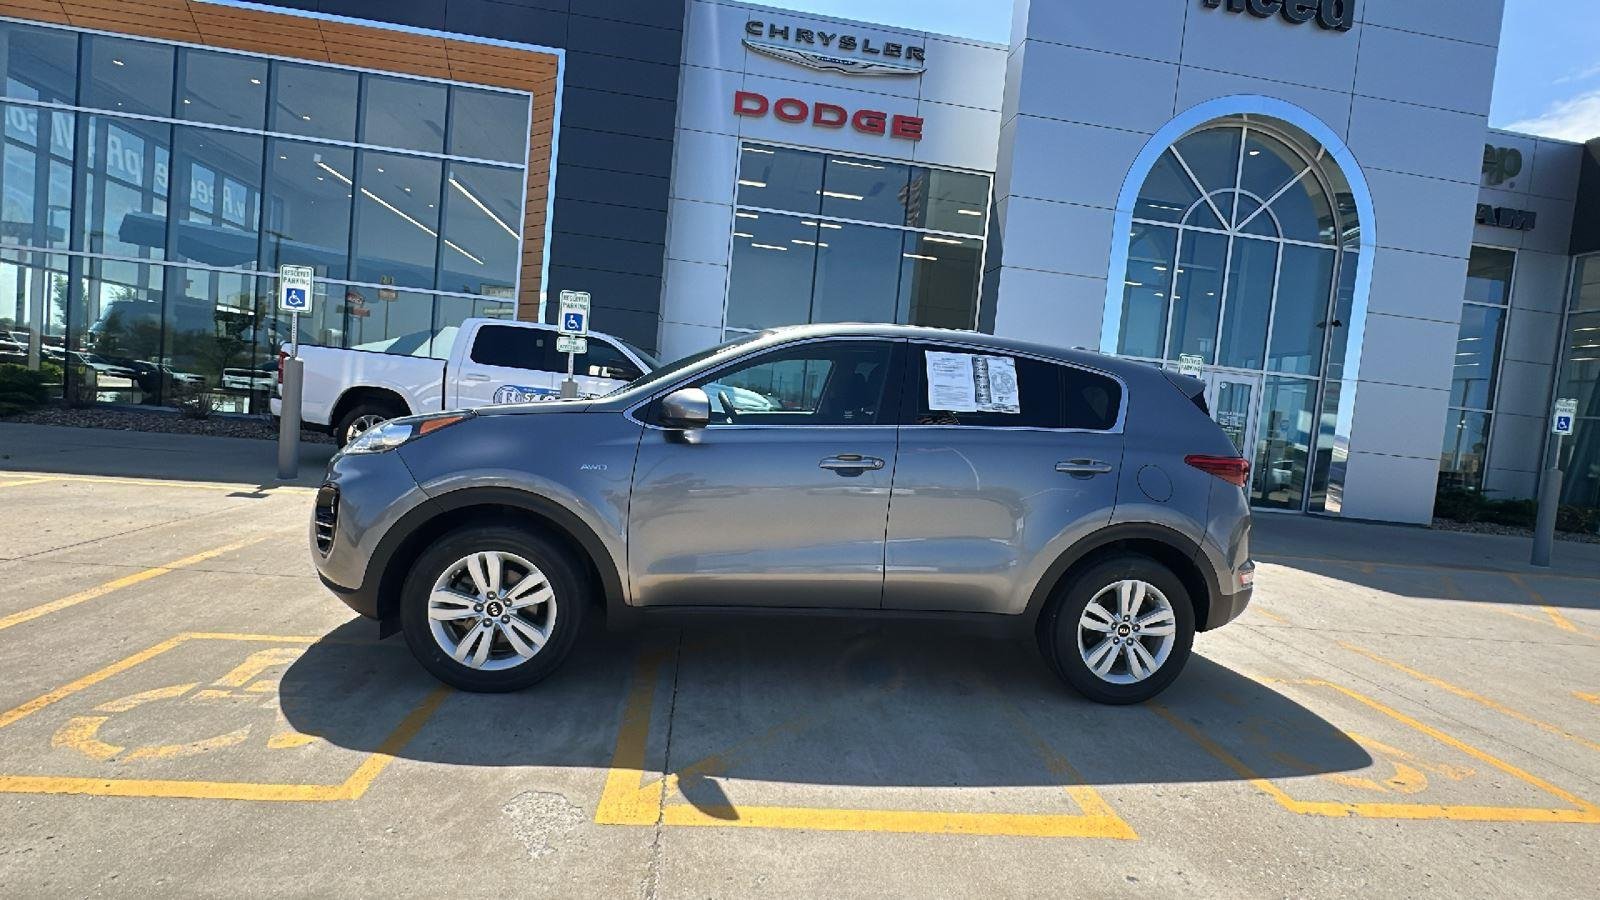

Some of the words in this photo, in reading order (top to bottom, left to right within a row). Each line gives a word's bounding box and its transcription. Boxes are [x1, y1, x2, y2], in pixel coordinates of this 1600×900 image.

[1203, 0, 1355, 32] eed
[745, 20, 925, 61] CHRYSLER
[734, 90, 924, 141] DODGE
[1475, 202, 1537, 231] AM
[283, 277, 310, 286] PARKING
[562, 302, 587, 310] PARKING
